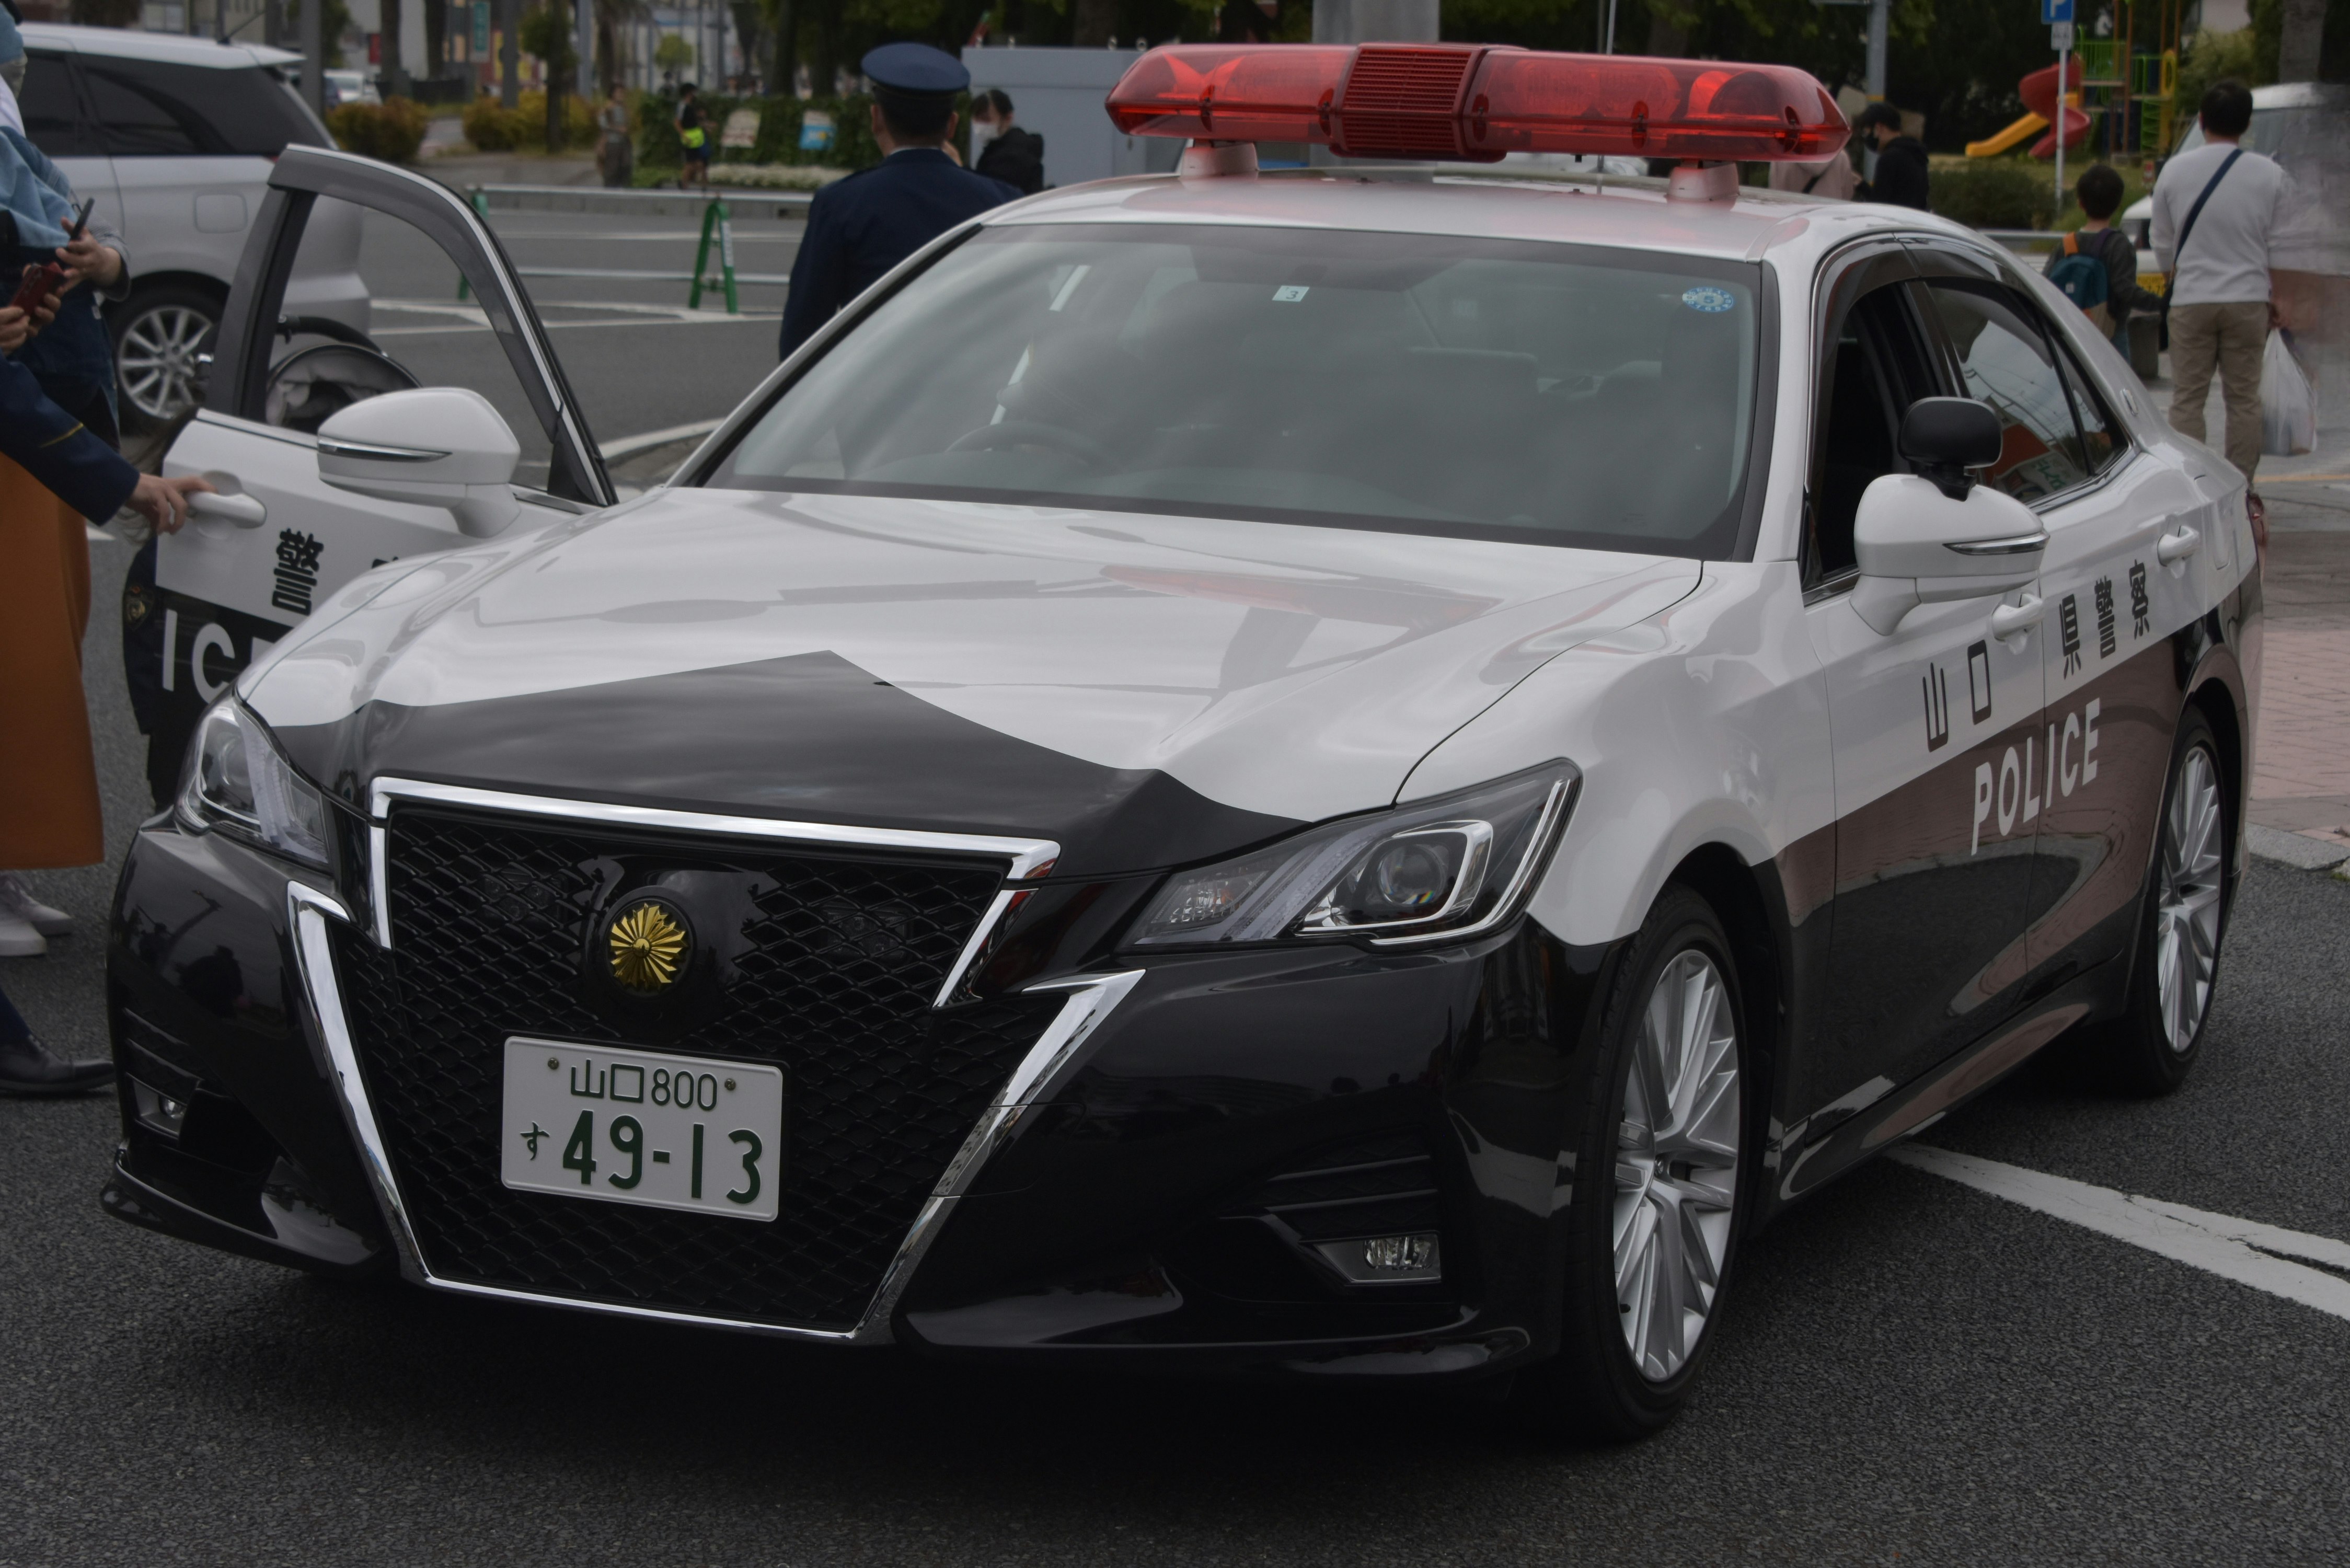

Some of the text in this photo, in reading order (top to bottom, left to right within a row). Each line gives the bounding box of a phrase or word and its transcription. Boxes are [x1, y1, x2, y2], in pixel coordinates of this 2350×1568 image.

[1286, 291, 1298, 299] 3
[1971, 697, 2100, 856] POLICE
[520, 1110, 762, 1204] す 49-13
